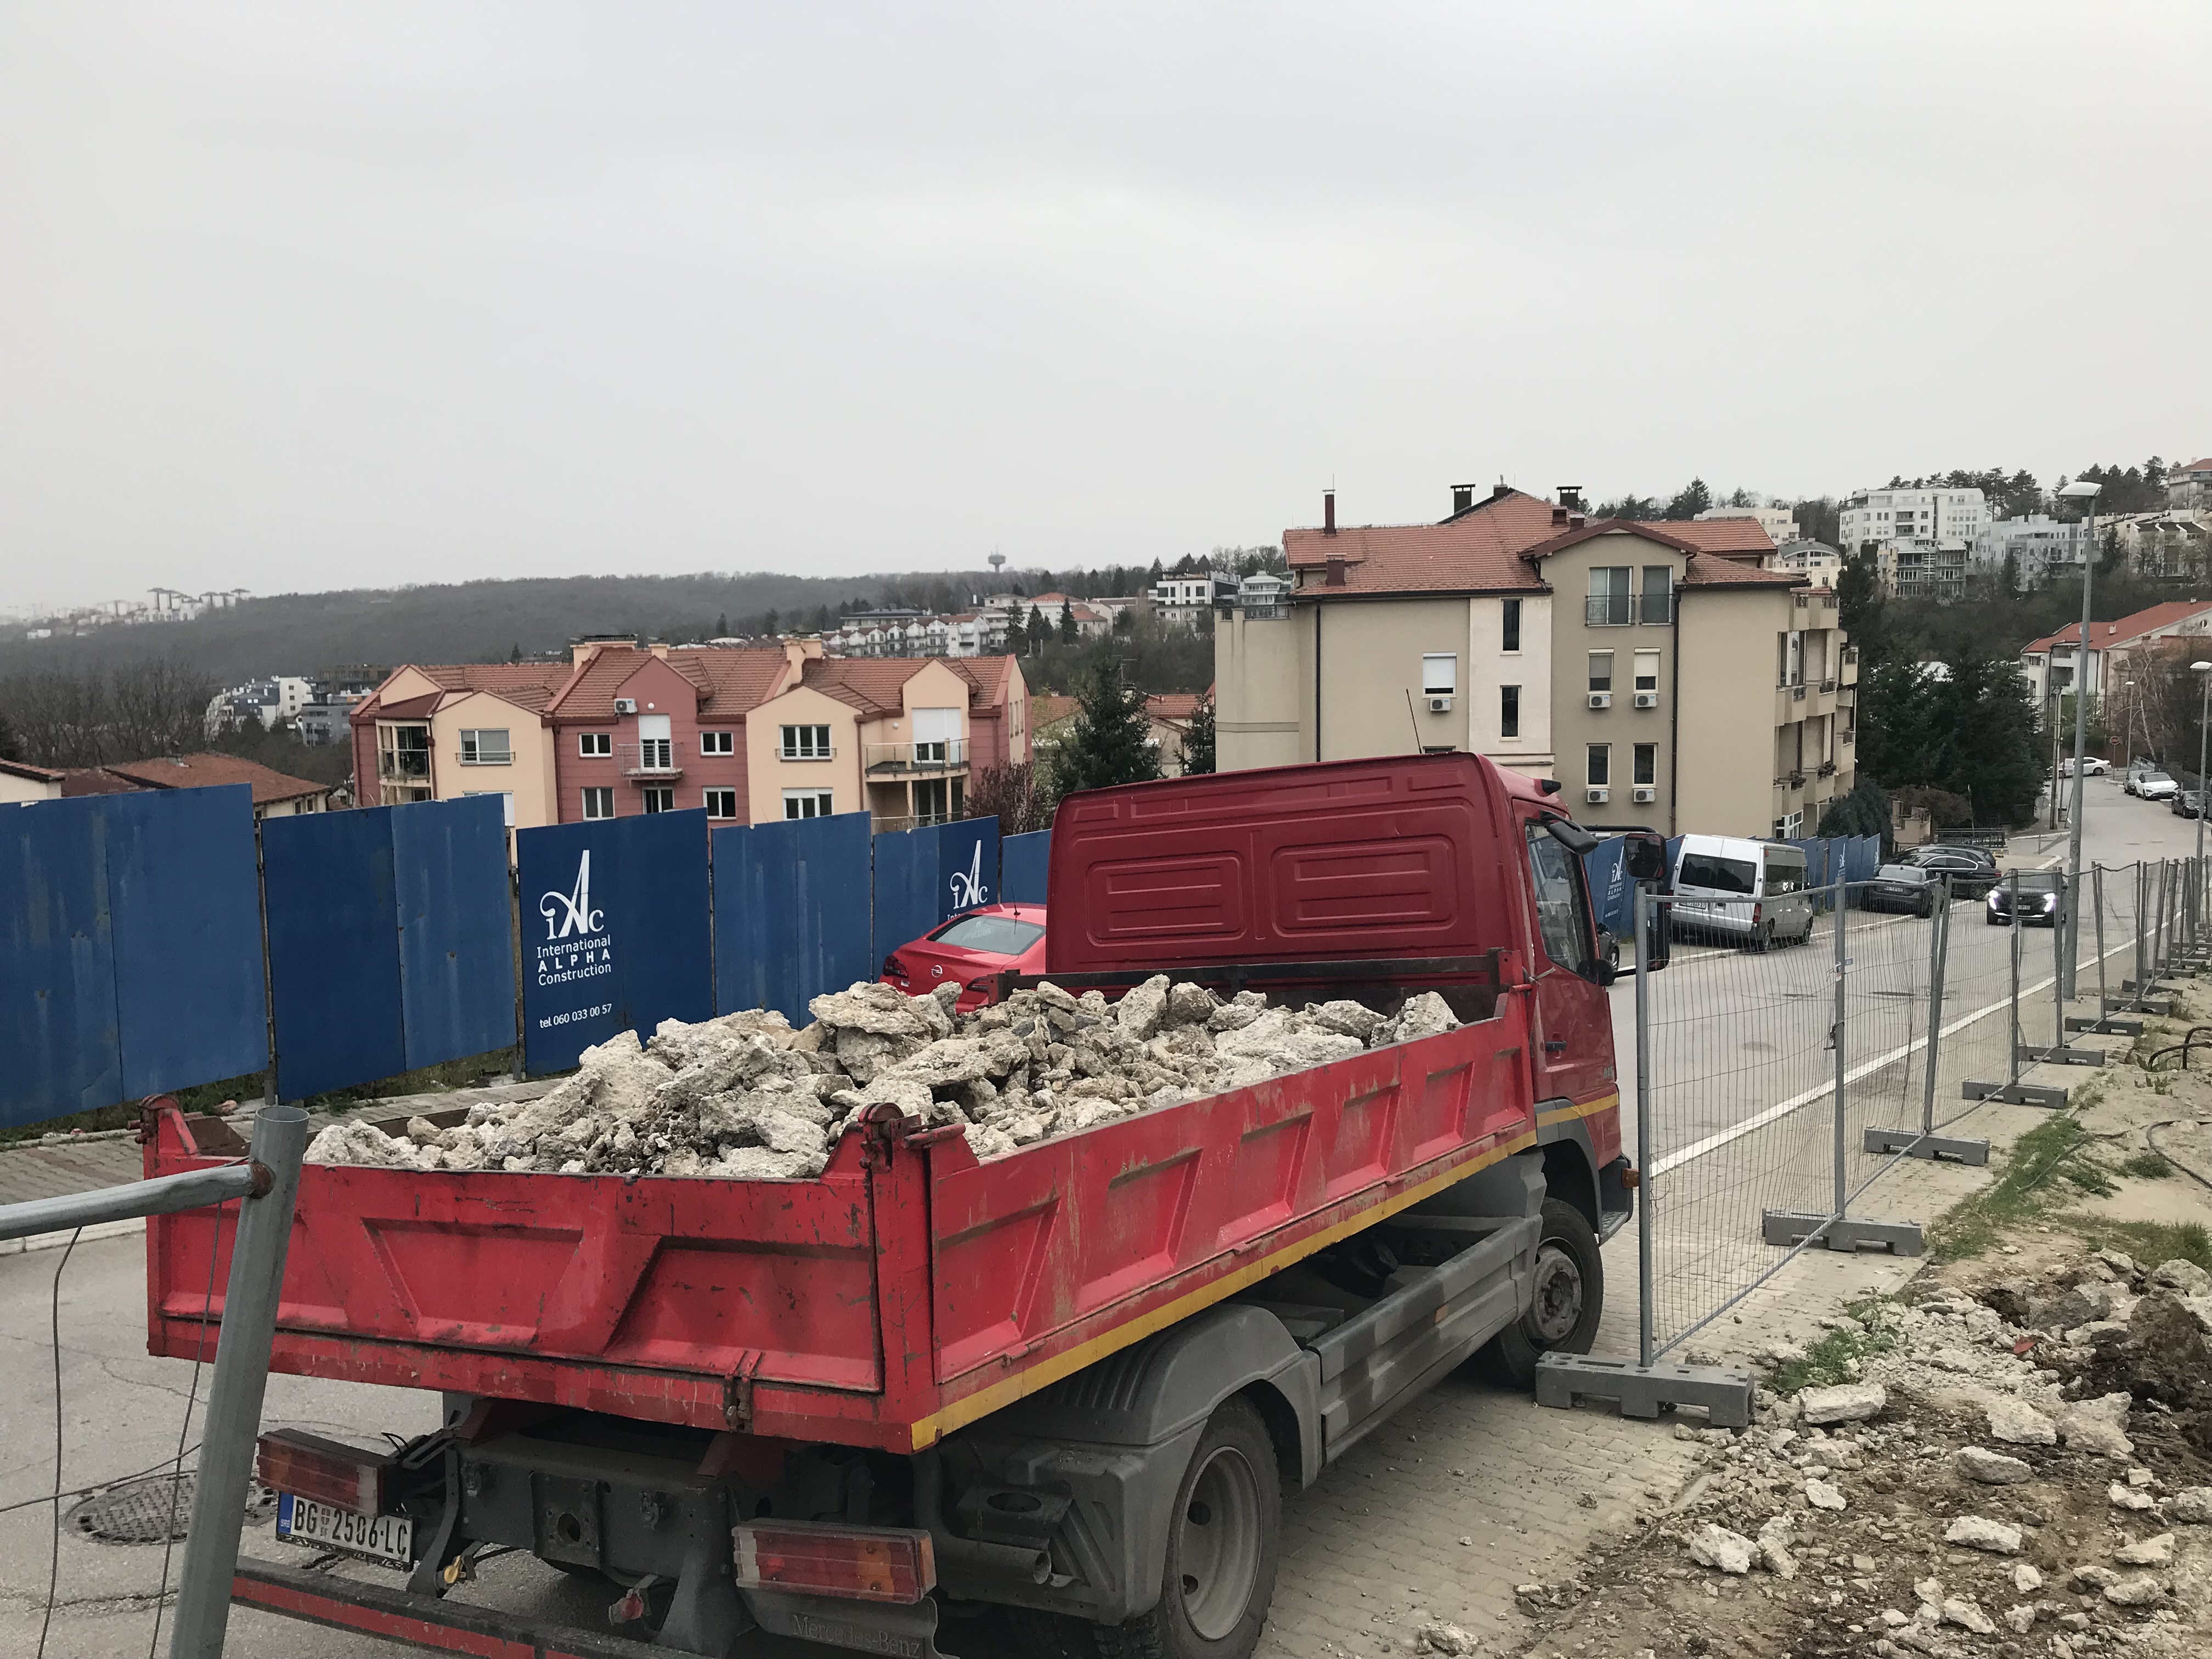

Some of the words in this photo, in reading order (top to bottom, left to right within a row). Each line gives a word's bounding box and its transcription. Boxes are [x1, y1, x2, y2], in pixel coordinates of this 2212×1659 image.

[537, 934, 611, 958] International
[538, 948, 611, 973] ALPHA
[538, 963, 612, 986] Construction
[553, 1013, 569, 1025] 060
[572, 1008, 588, 1022] 033
[589, 1006, 600, 1017] 00
[602, 1003, 612, 1014] 57
[294, 1499, 318, 1534] BG
[792, 1614, 921, 1658] Mercedes-Benz
